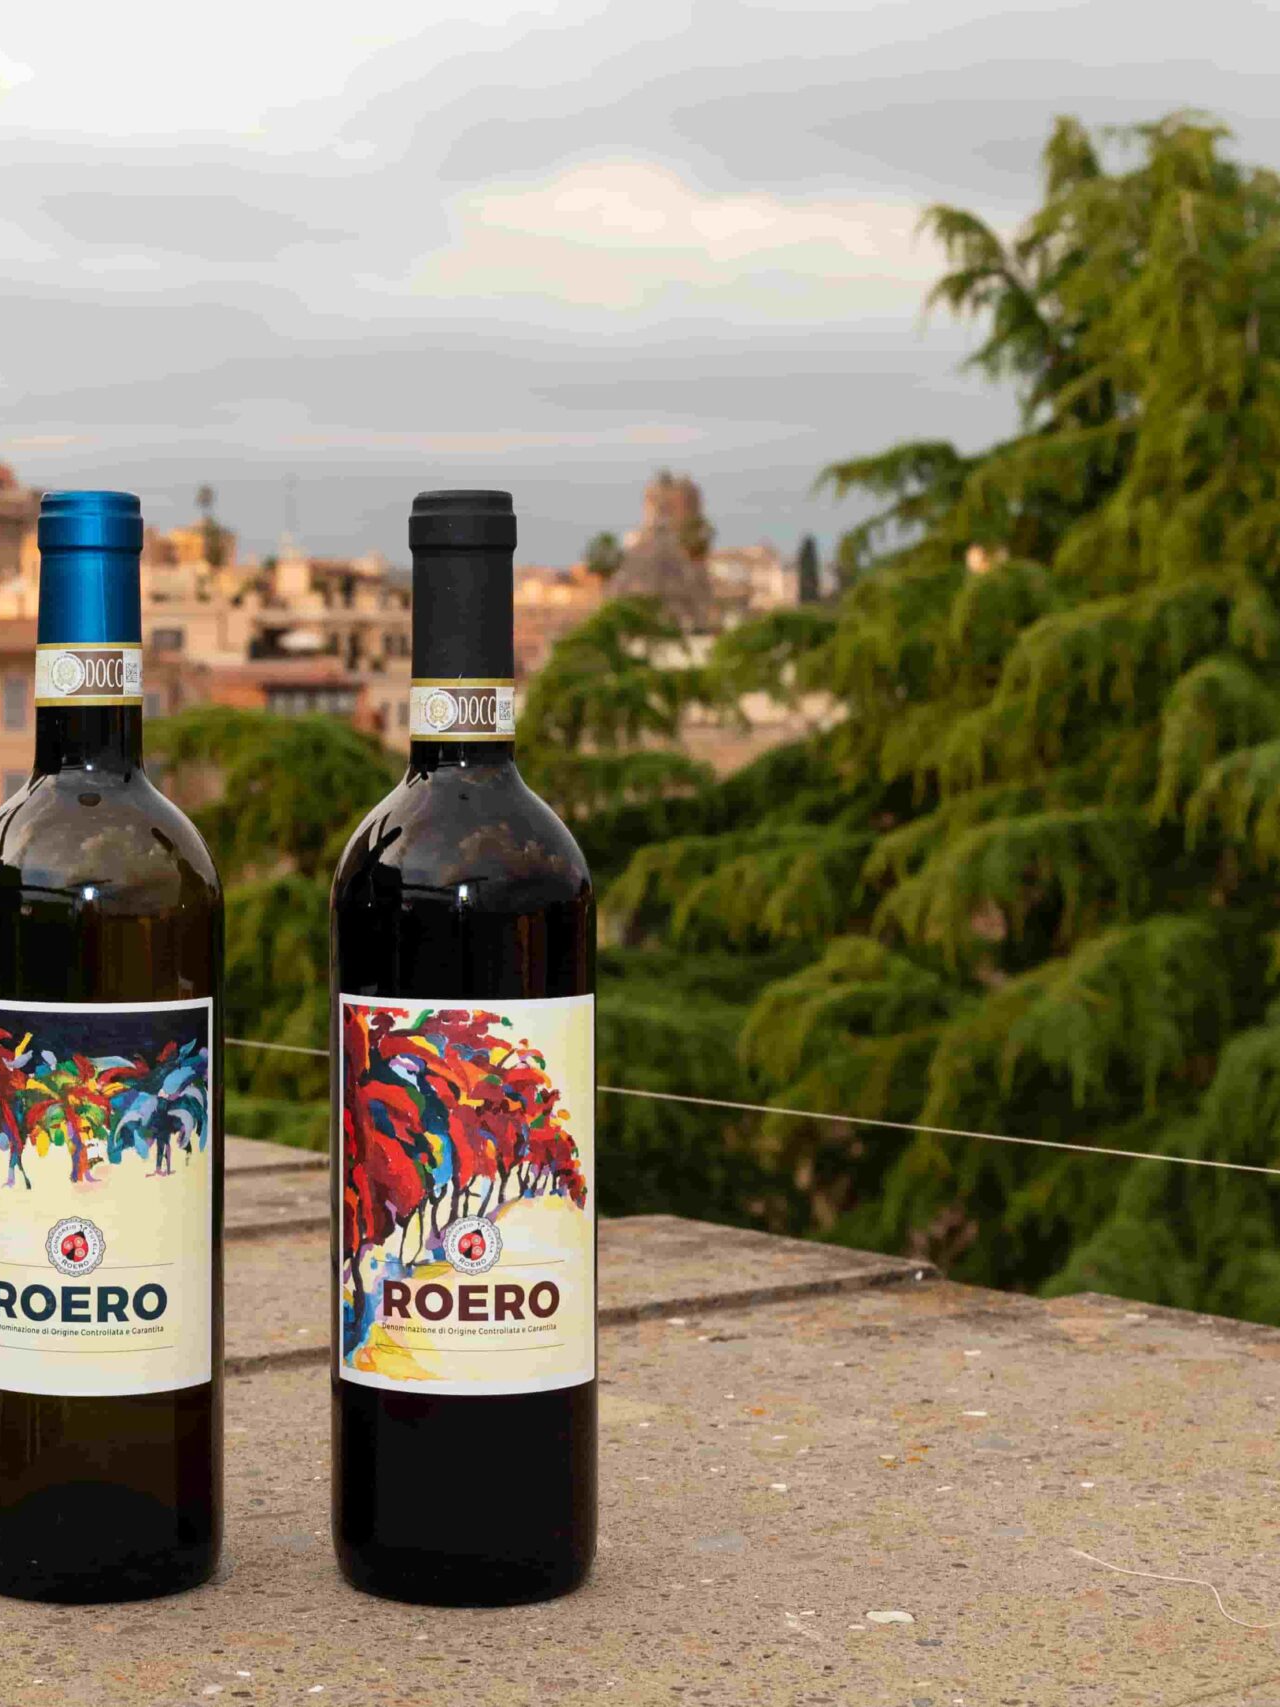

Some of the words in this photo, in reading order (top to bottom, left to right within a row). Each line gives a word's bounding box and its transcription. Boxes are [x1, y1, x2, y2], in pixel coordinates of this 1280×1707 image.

[85, 658, 123, 688] DOCG
[458, 695, 496, 725] DOCG
[61, 1258, 89, 1269] ROERO
[459, 1257, 487, 1268] ROERO
[382, 1279, 560, 1322] ROERO
[51, 1328, 79, 1337] Origine
[80, 1328, 124, 1336] Controllata
[381, 1322, 436, 1334] Denominazione
[447, 1327, 477, 1336] Origine
[478, 1327, 520, 1335] Controllata
